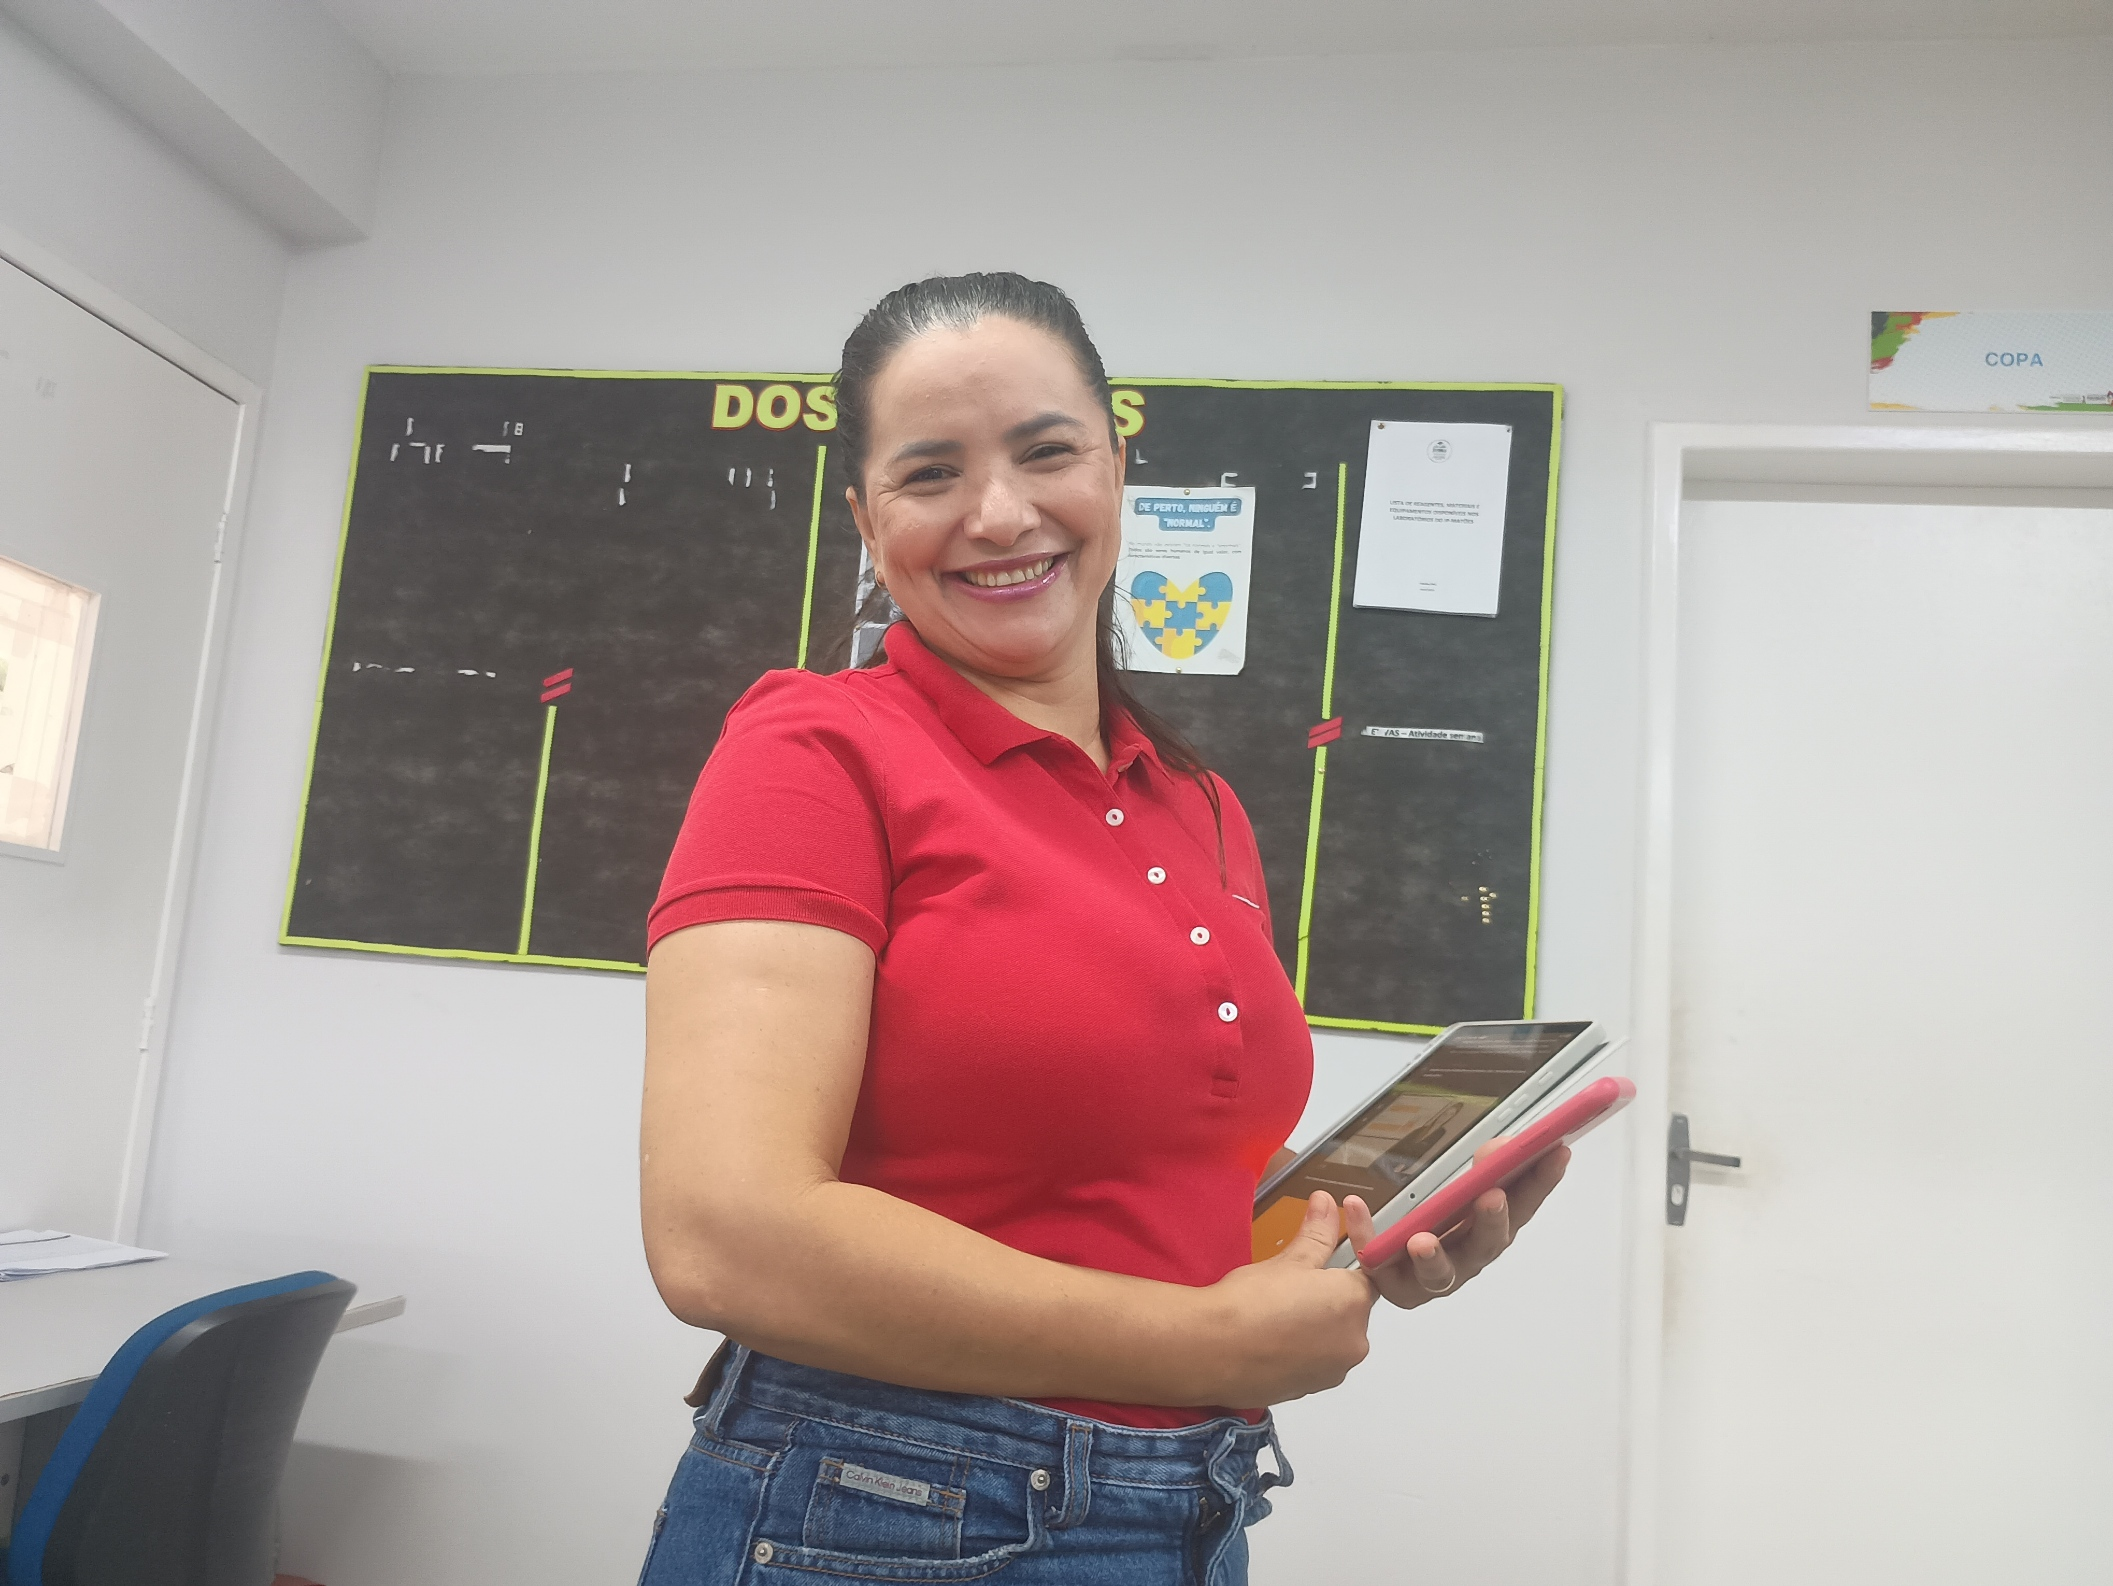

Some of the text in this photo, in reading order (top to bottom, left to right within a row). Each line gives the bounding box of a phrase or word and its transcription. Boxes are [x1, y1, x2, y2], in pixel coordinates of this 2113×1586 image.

[1985, 352, 2043, 367] COPA
[1138, 501, 1238, 513] DE PERTO, NINGUÉM É
[1408, 730, 1448, 739] Atividade
[846, 1470, 923, 1497] Calvin Klein Jeans
